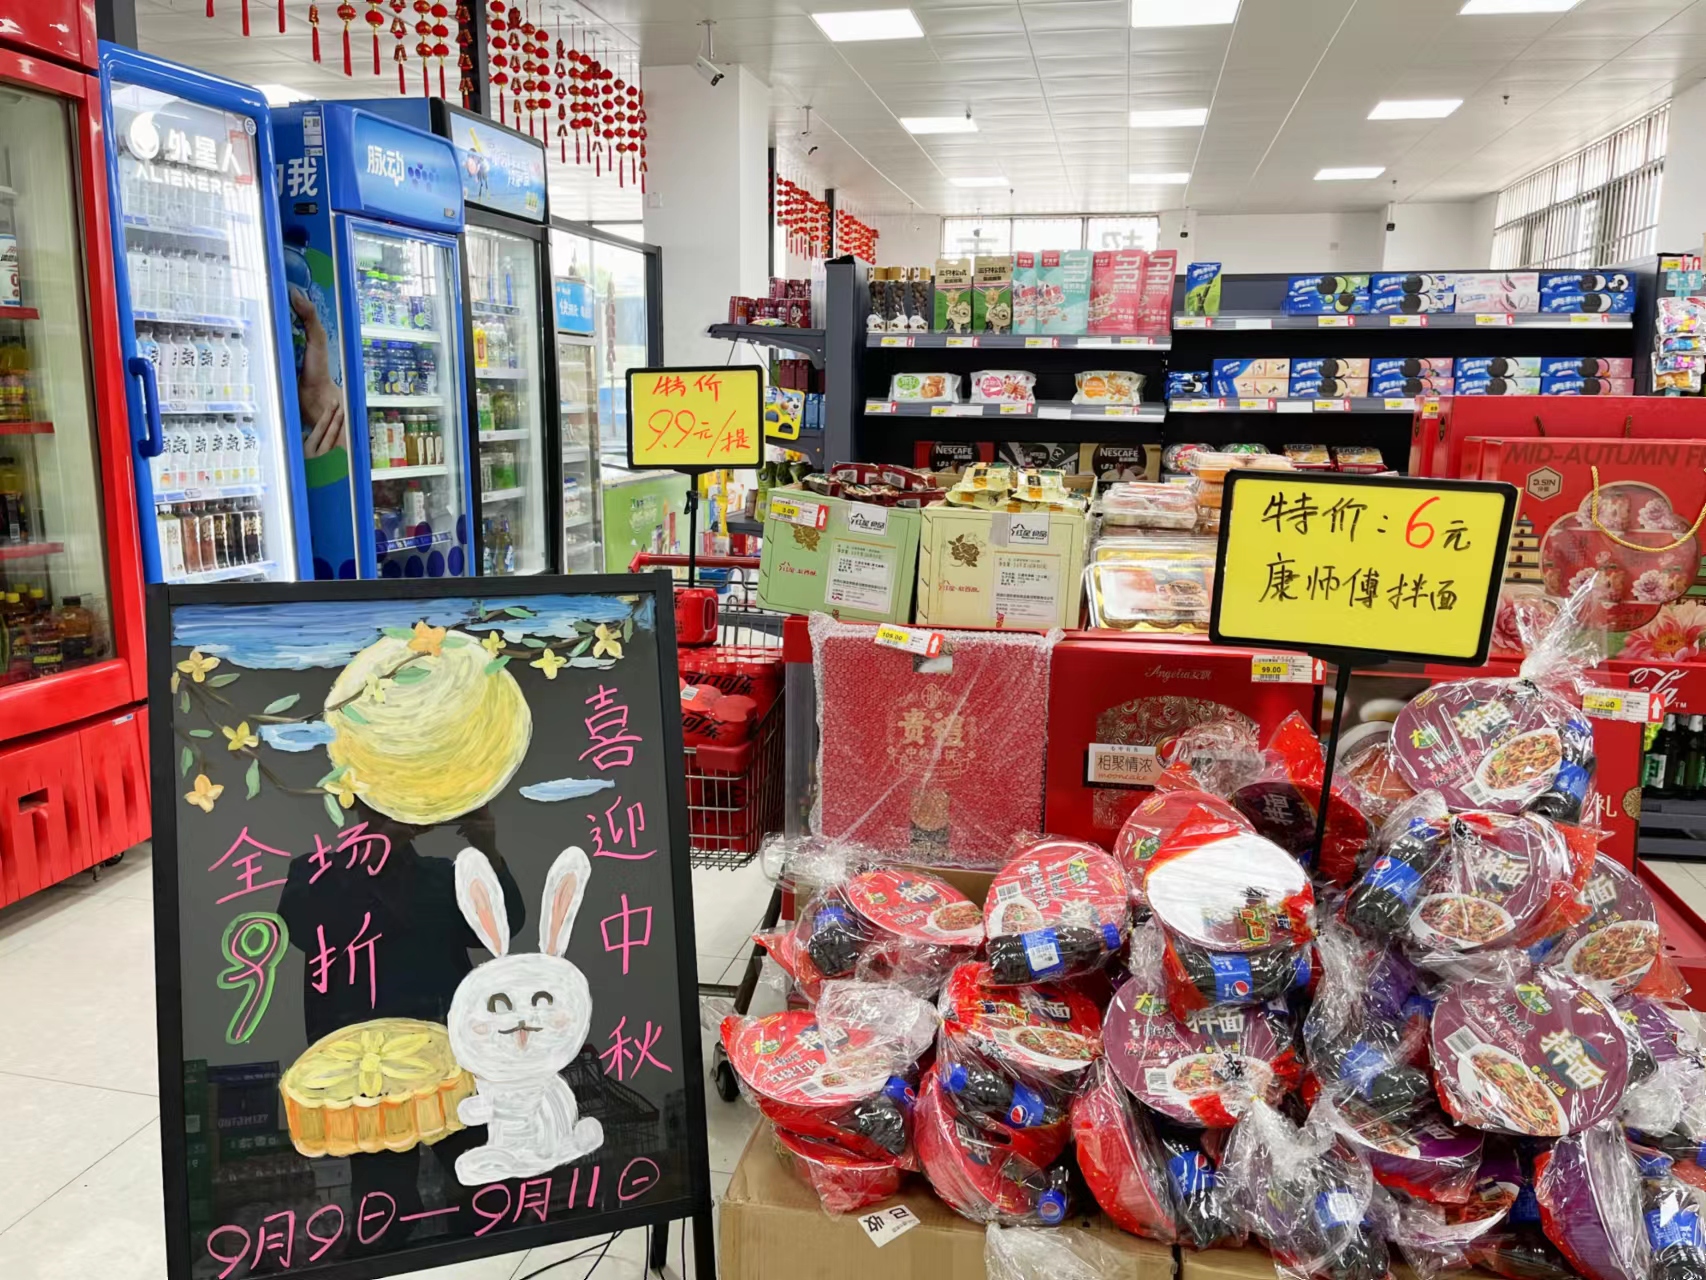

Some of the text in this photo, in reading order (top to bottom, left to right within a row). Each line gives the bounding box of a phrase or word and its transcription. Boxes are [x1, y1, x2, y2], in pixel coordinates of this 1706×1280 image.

[164, 128, 242, 175] 外星人
[367, 144, 405, 187] 脉动
[652, 373, 722, 402] 特价
[1504, 443, 1678, 464] MID-AUTUMN
[1258, 552, 1458, 611] 康师傅拌面
[882, 631, 903, 641] 109.00
[680, 711, 728, 740] 可乐
[1098, 755, 1153, 772] 相聚情浓
[207, 821, 391, 904] 全场
[579, 685, 672, 1081] 喜迎中秋
[217, 911, 383, 1046] 9折
[1539, 1027, 1608, 1090] 拌面
